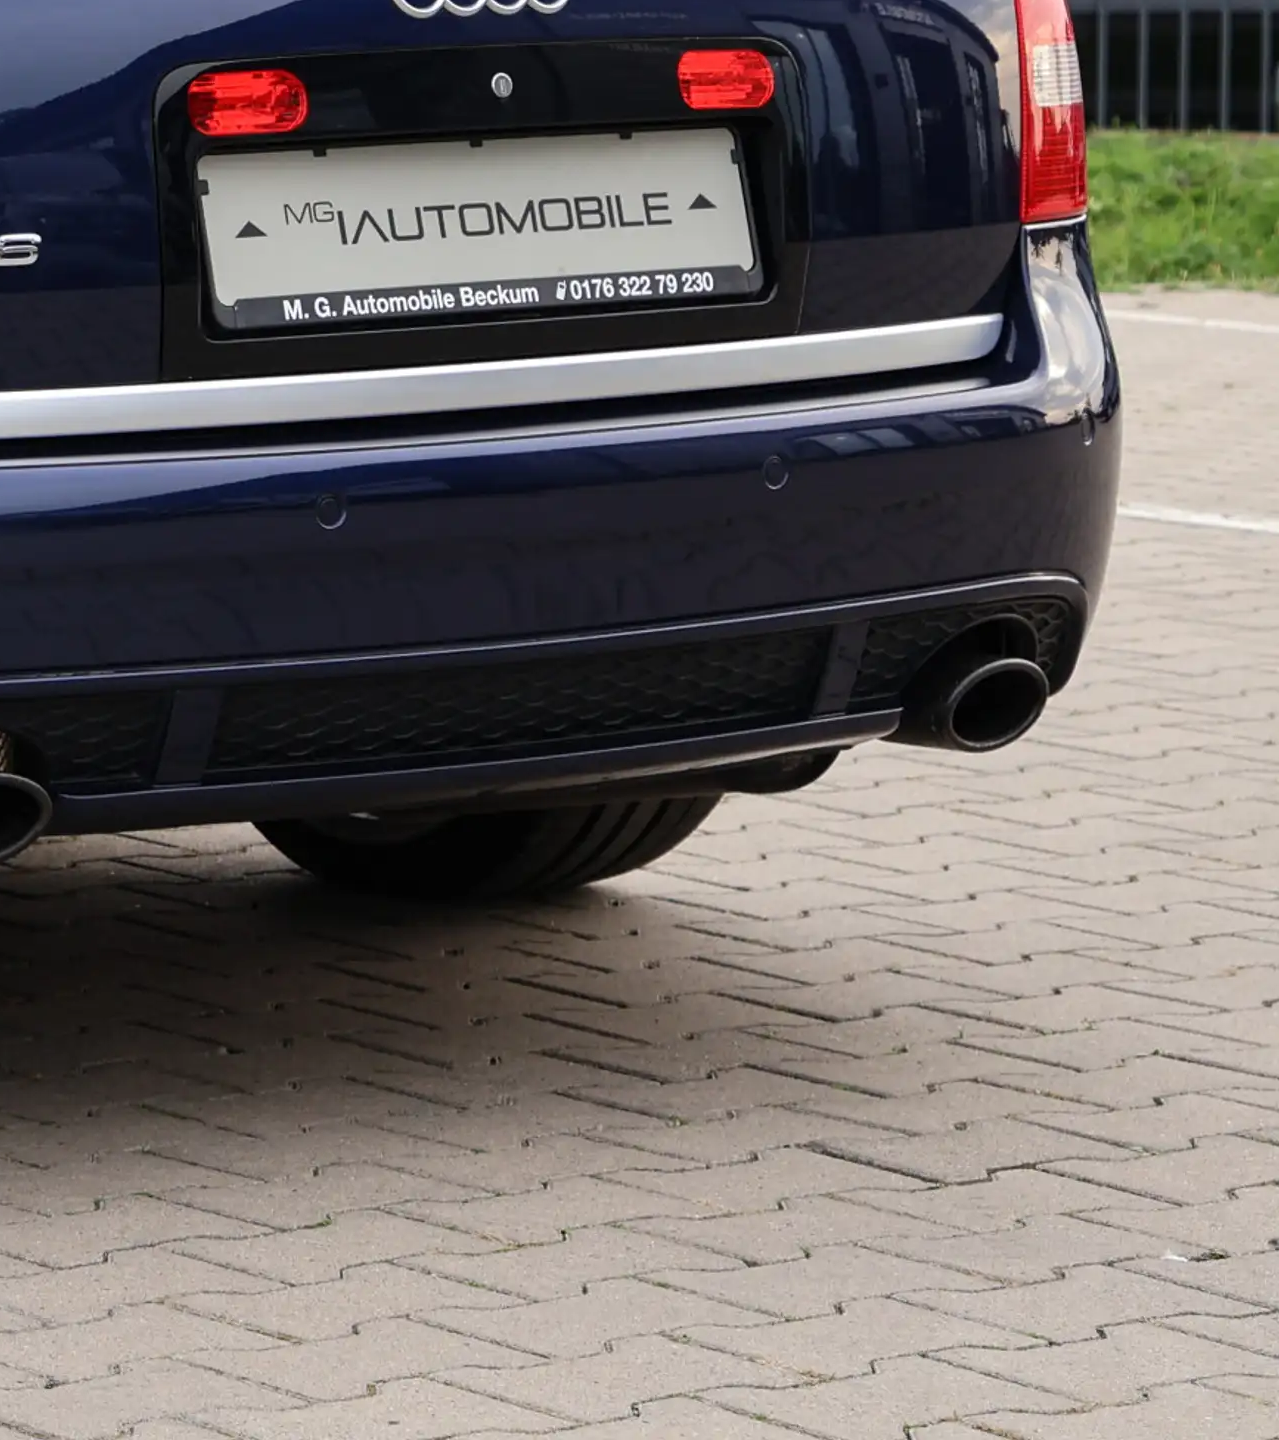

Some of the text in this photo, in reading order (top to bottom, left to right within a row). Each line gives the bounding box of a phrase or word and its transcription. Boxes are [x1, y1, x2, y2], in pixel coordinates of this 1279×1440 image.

[283, 201, 335, 225] MG
[282, 271, 714, 321] M. G. Automobile Beckum 0176 322 79 230
